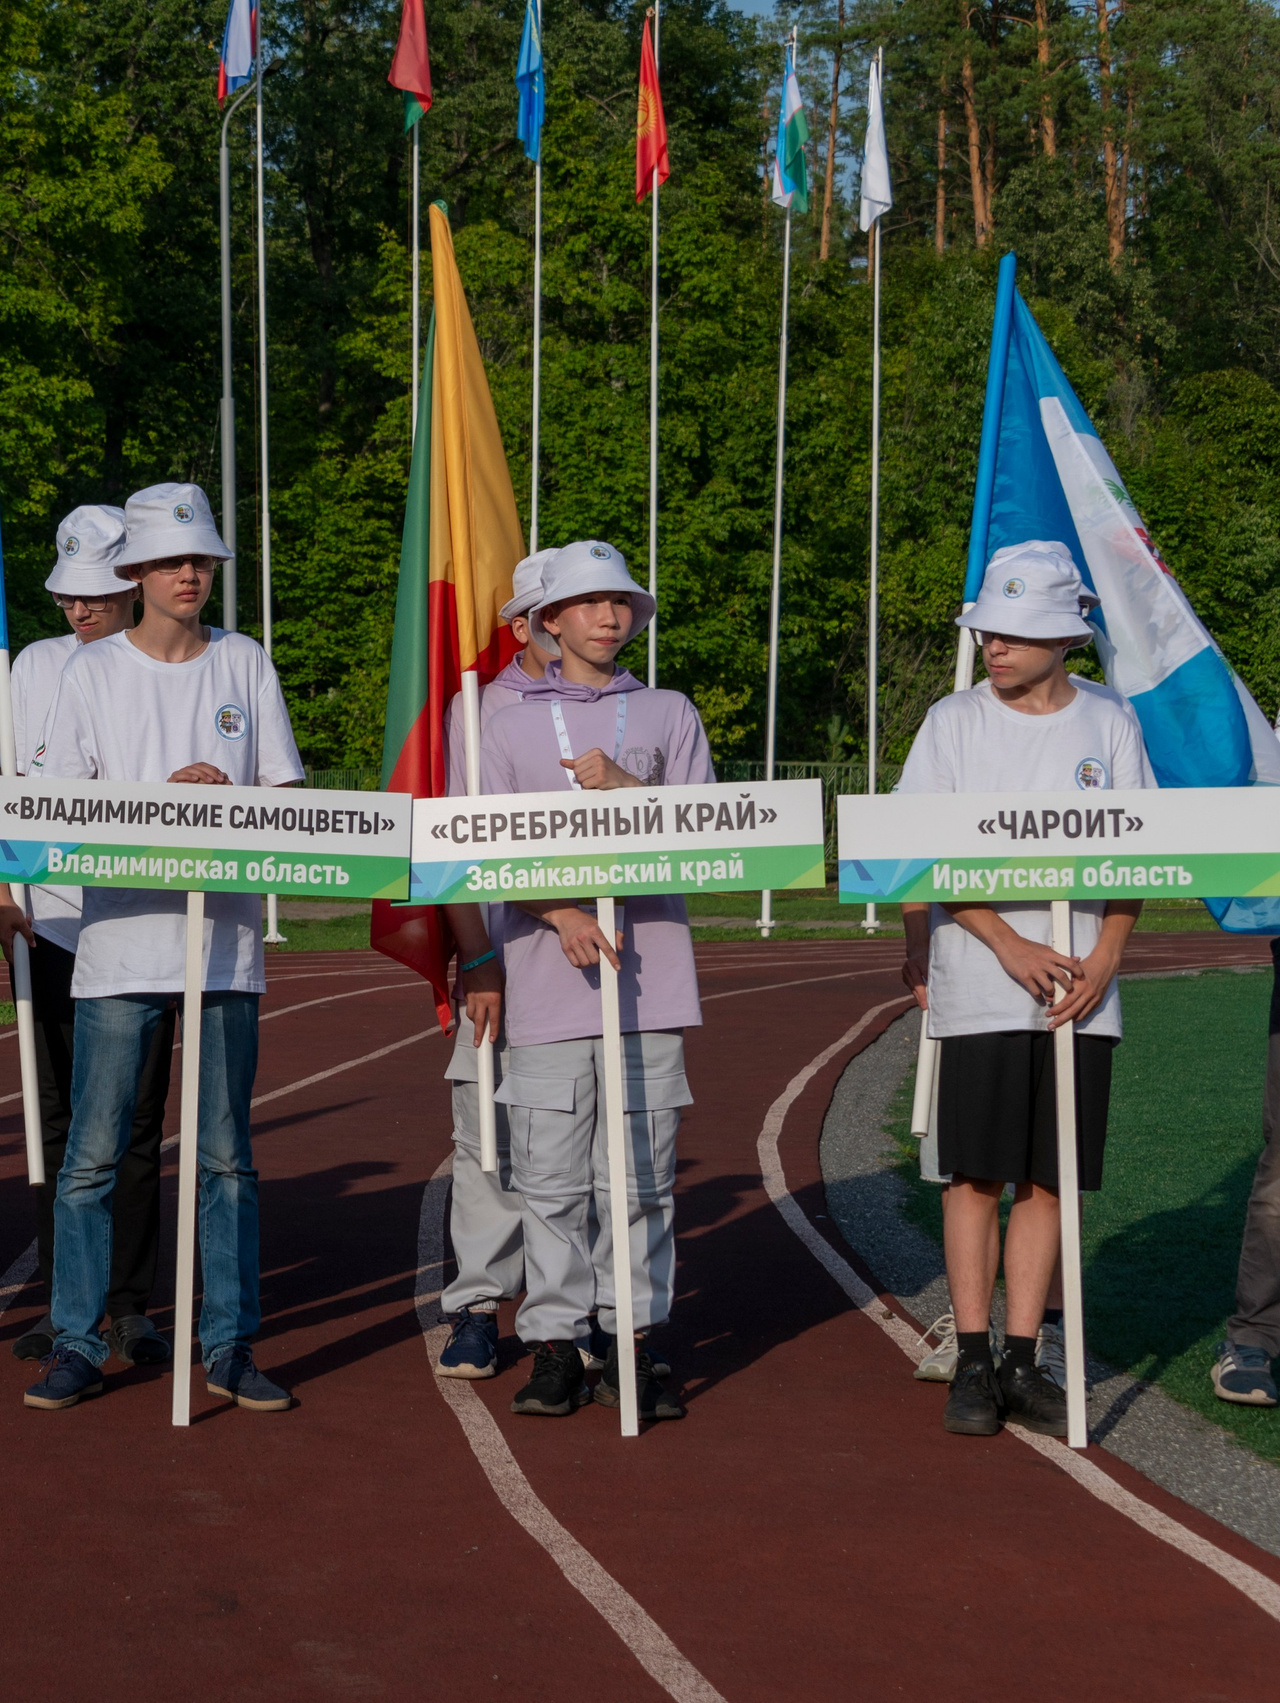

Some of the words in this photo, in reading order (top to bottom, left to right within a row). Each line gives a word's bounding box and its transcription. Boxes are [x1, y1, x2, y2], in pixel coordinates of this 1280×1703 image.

[4, 796, 222, 829] «ВЛАДИМИРСКИЕ
[230, 803, 396, 836] САМОЦВЕТЫ»
[431, 797, 663, 843] «СЕРЕБРЯНЫЙ
[675, 793, 777, 832] КРАЙ»
[977, 809, 1144, 840] «ЧАРОИТ»
[47, 847, 236, 883] Владимирская
[245, 853, 350, 885] область
[466, 854, 671, 891] Забайкальский
[680, 852, 744, 886] край
[932, 862, 1075, 895] Иркутская
[1081, 858, 1193, 889] область
